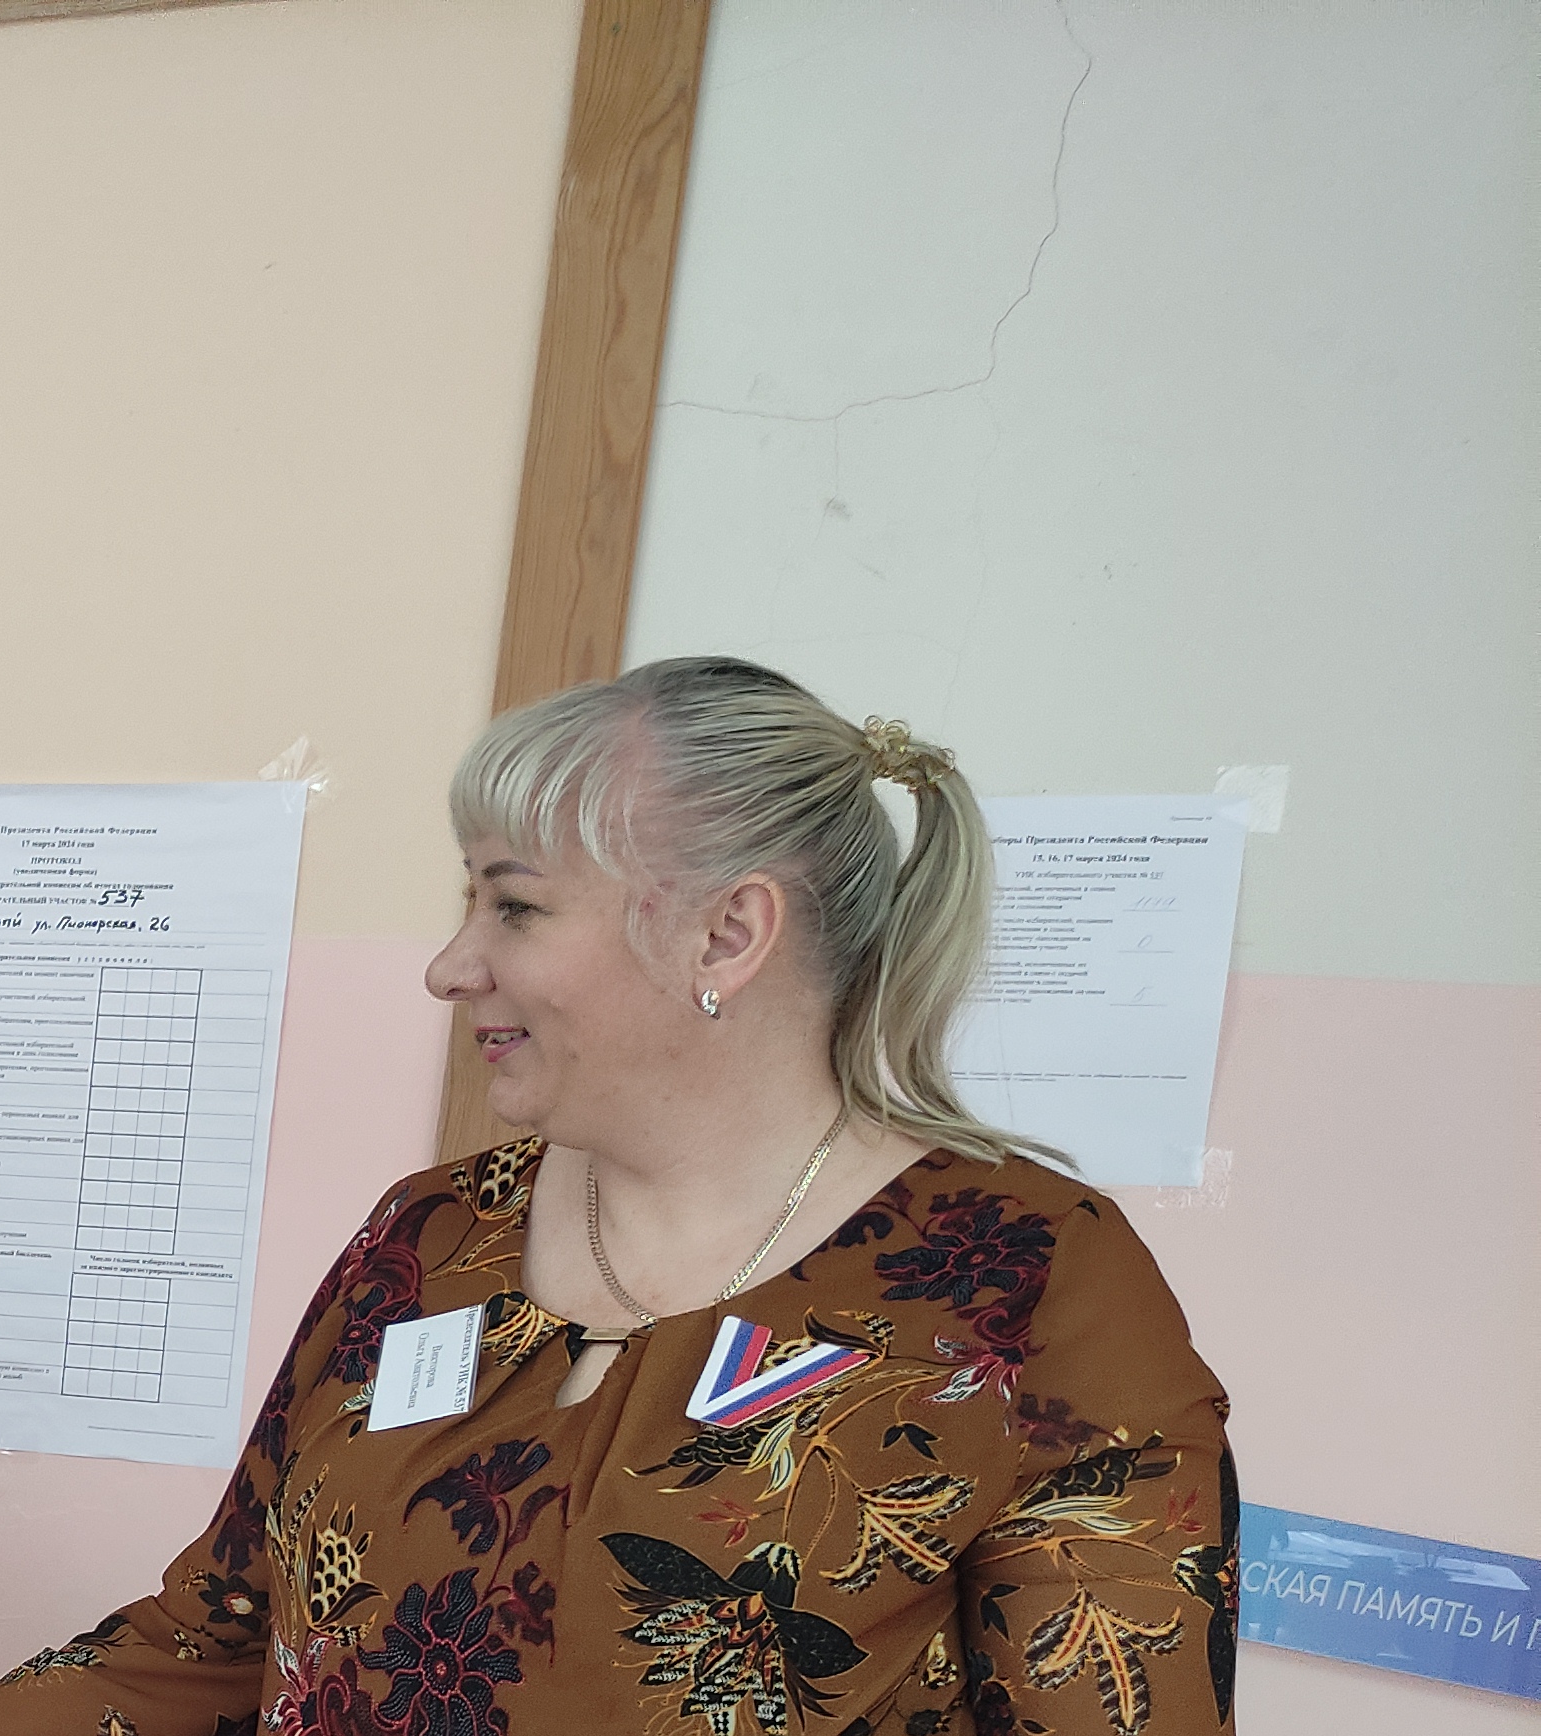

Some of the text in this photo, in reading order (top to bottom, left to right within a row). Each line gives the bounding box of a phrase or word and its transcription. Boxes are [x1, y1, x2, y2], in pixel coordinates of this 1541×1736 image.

[97, 889, 145, 908] 537
[148, 915, 171, 932] 26
[1239, 1558, 1331, 1607] СКАЯ
[1337, 1580, 1482, 1638] ПАМЯТЬ
[1490, 1609, 1522, 1646] И
